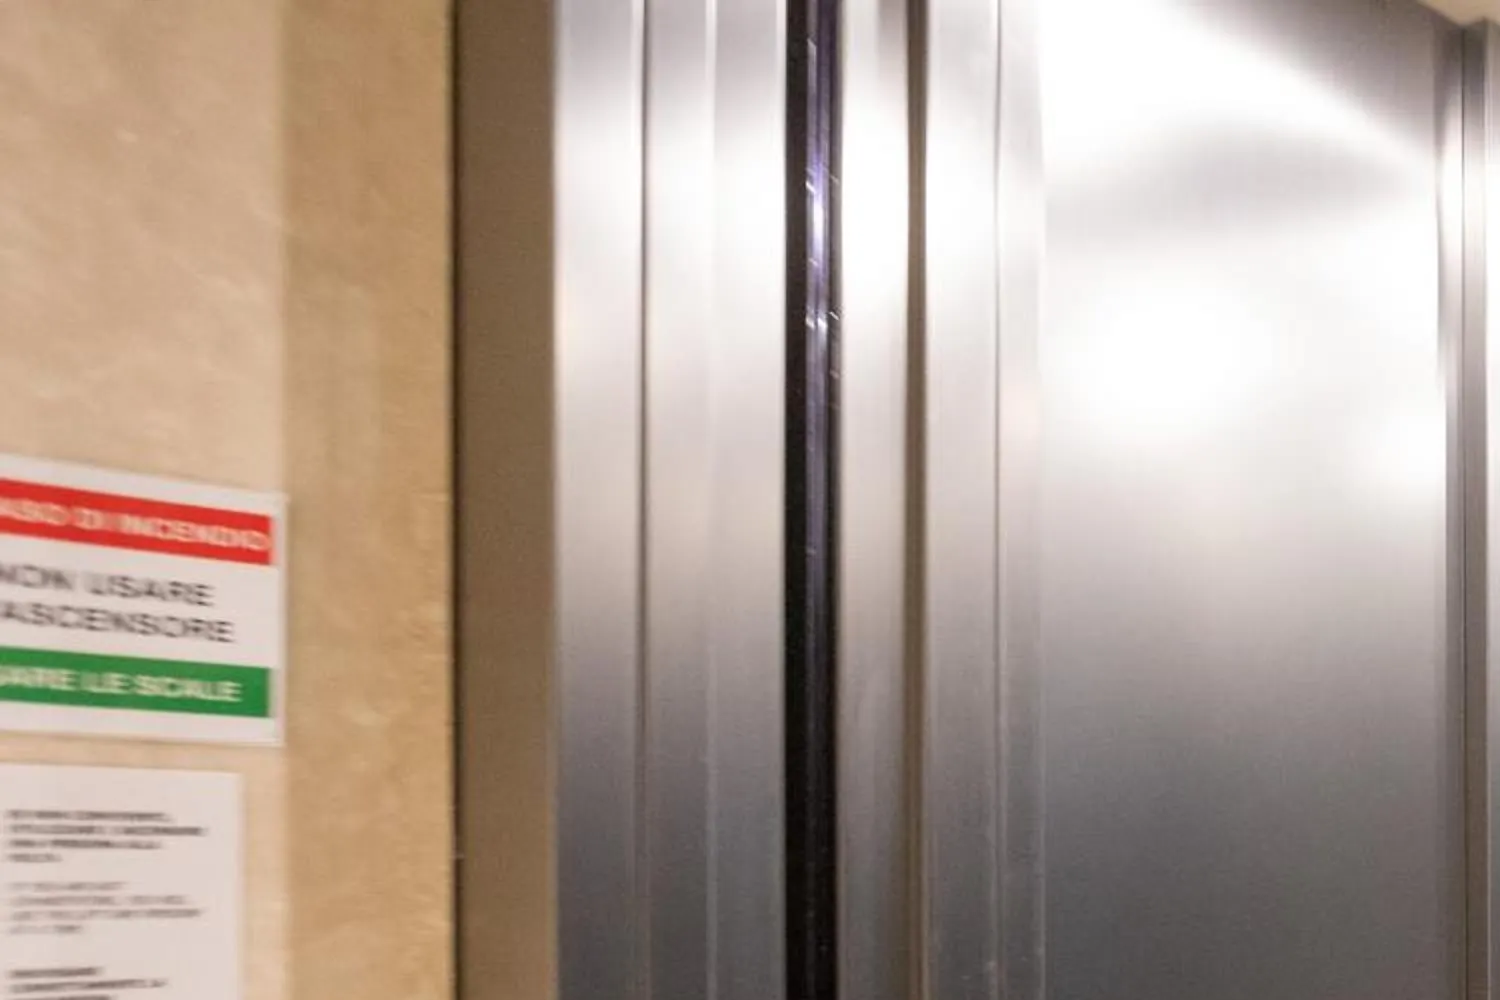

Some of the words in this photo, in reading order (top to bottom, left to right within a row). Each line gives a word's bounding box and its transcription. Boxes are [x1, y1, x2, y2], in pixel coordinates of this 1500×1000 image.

[0, 562, 73, 591] NON
[84, 570, 215, 607] USARE
[82, 672, 131, 694] LE
[132, 674, 243, 702] SCALE
